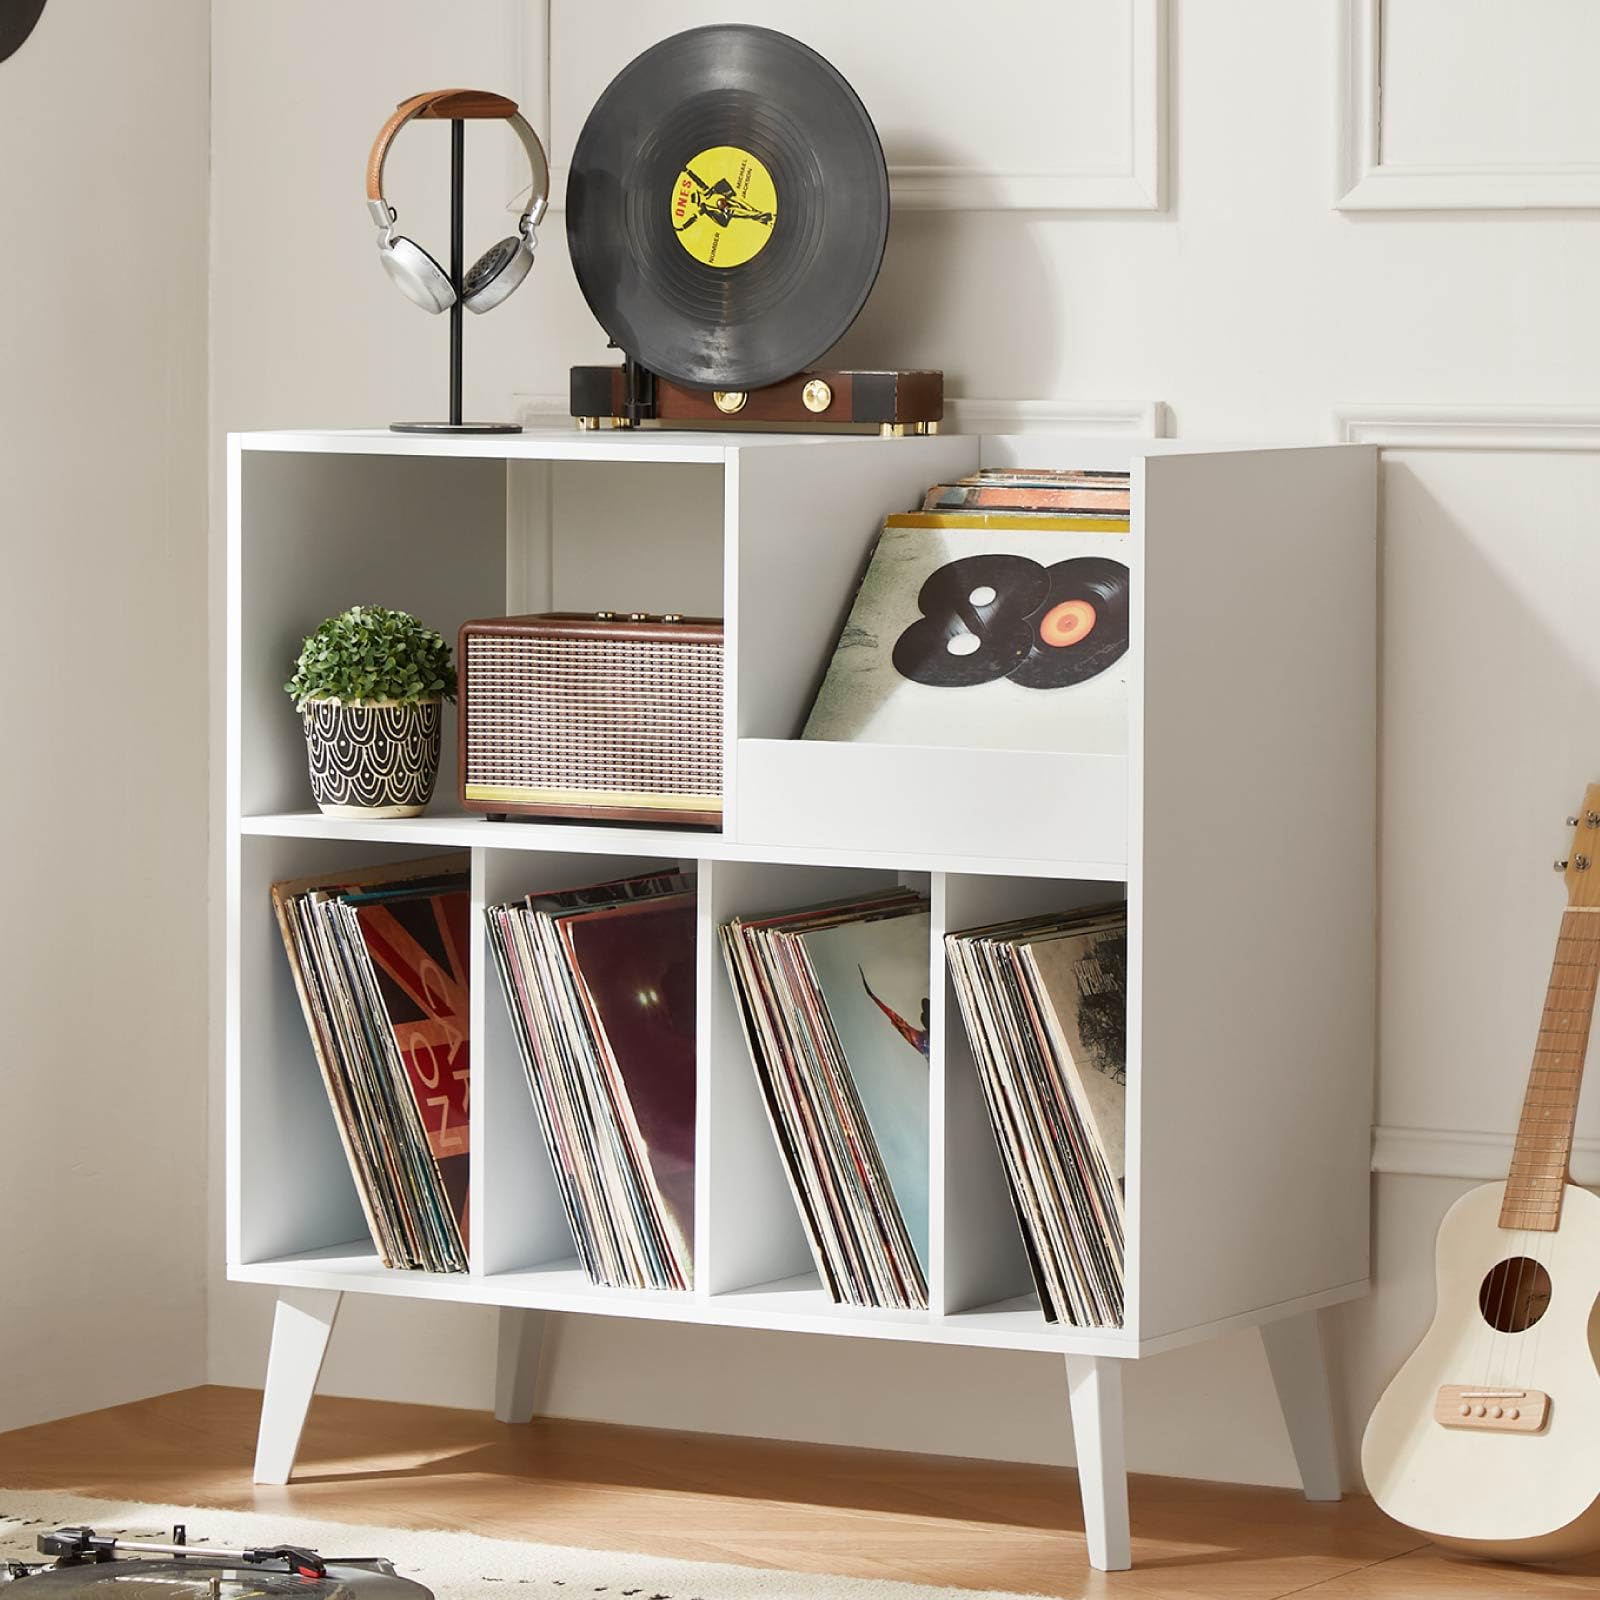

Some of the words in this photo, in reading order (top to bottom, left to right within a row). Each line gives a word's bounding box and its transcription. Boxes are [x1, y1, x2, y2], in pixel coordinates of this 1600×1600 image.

[736, 159, 748, 189] MICHAEL
[742, 168, 753, 199] JACKSON
[675, 179, 692, 217] ONES
[708, 232, 720, 264] NUMBER
